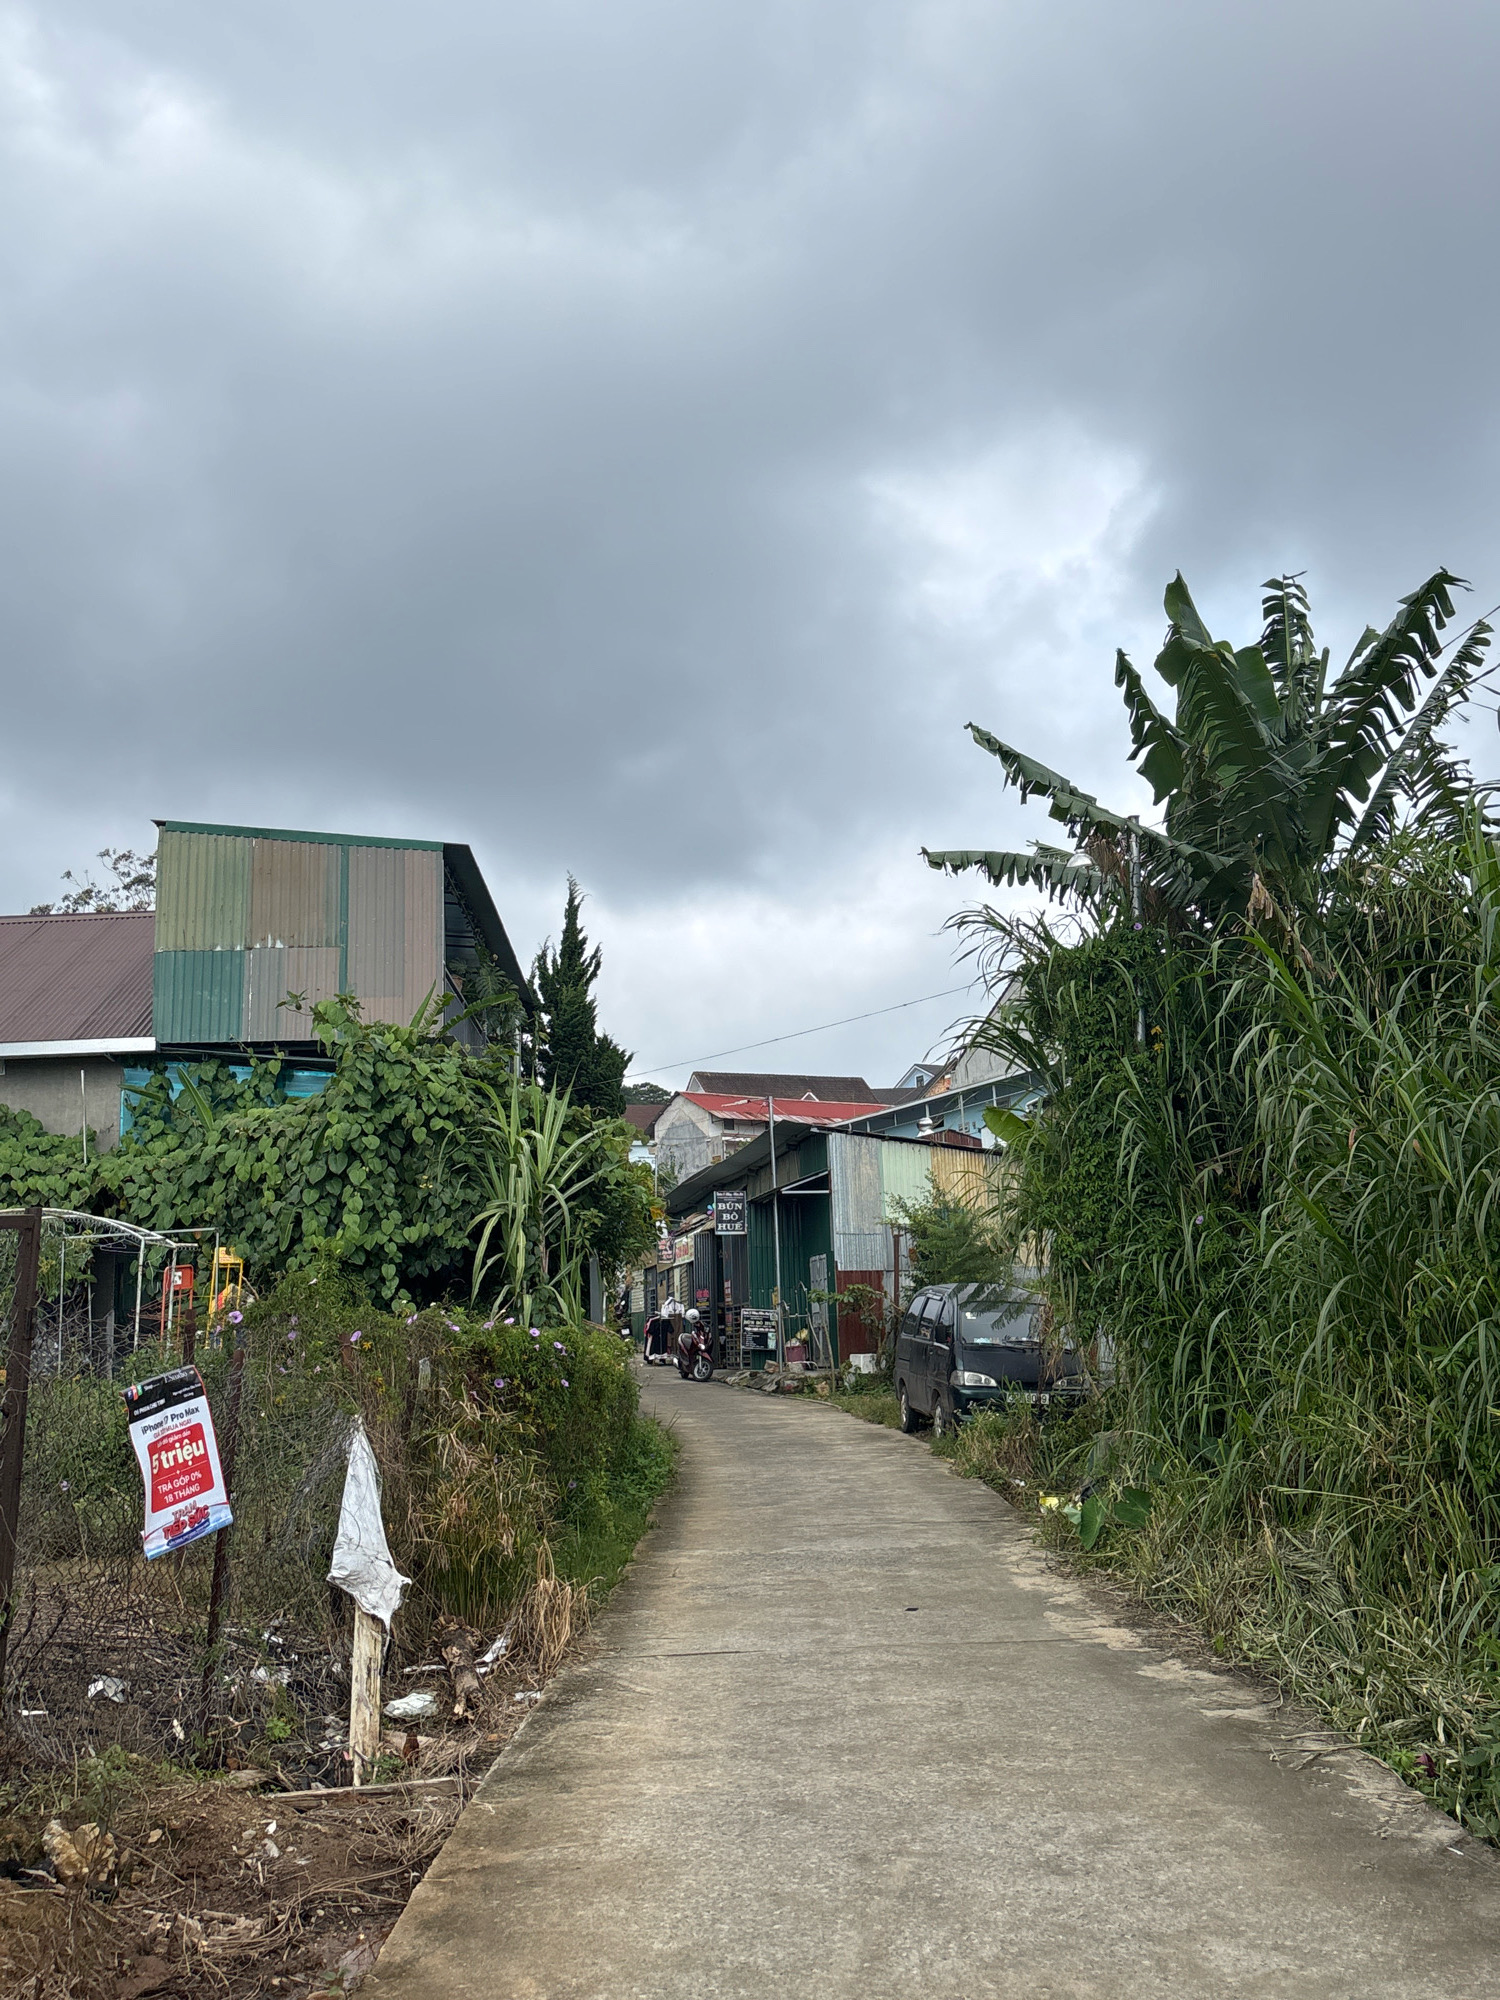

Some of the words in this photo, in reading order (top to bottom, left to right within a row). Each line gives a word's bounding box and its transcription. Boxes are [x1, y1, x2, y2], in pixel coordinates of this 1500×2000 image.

[718, 1201, 743, 1210] BÚN
[722, 1211, 739, 1220] BÒ
[717, 1220, 744, 1231] HUẾ
[141, 1420, 164, 1435] iPhone
[170, 1412, 185, 1422] Pro
[184, 1406, 200, 1417] Max
[152, 1453, 159, 1475] 5
[160, 1438, 205, 1469] triệu
[157, 1479, 173, 1494] TRẢ
[173, 1474, 190, 1488] GÓP
[190, 1470, 202, 1481] 0%
[163, 1493, 174, 1504] 18
[174, 1483, 201, 1500] THÁNG
